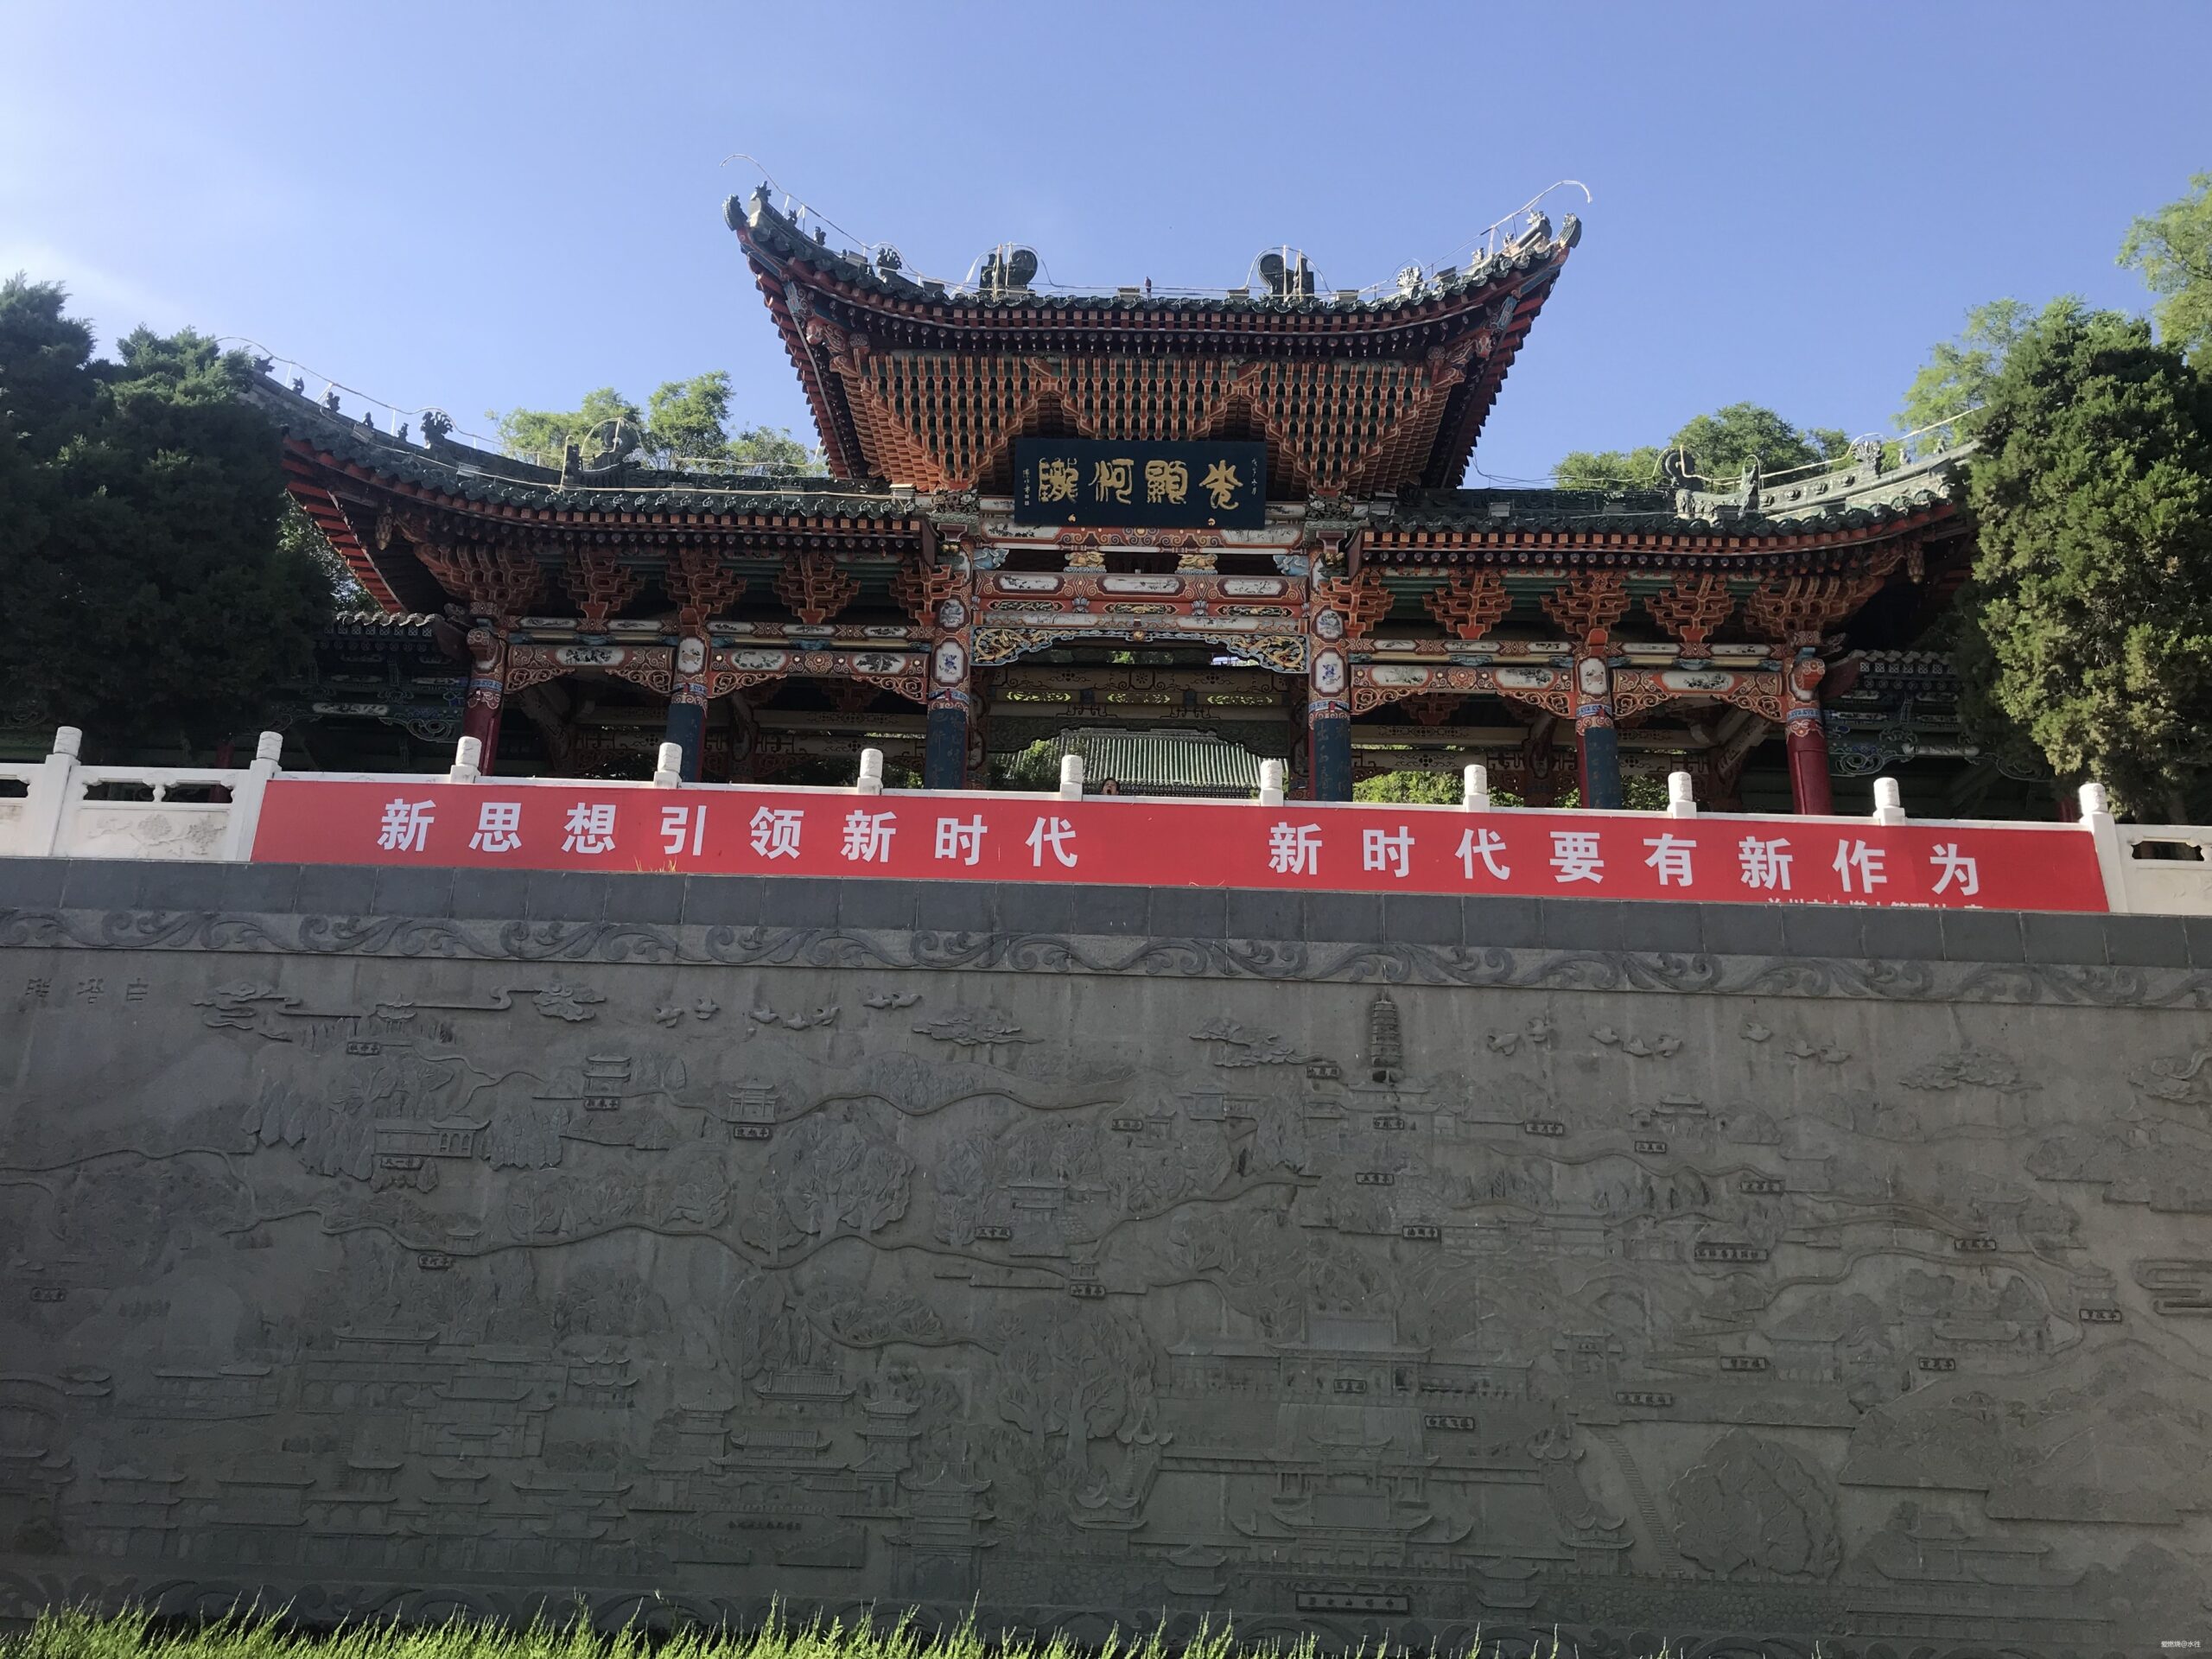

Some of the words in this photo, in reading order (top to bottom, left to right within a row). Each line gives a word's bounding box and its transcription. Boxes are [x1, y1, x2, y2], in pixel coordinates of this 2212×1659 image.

[378, 798, 1078, 868] 新思想引领新时代
[1268, 822, 1979, 896] 新时代要有新作为
